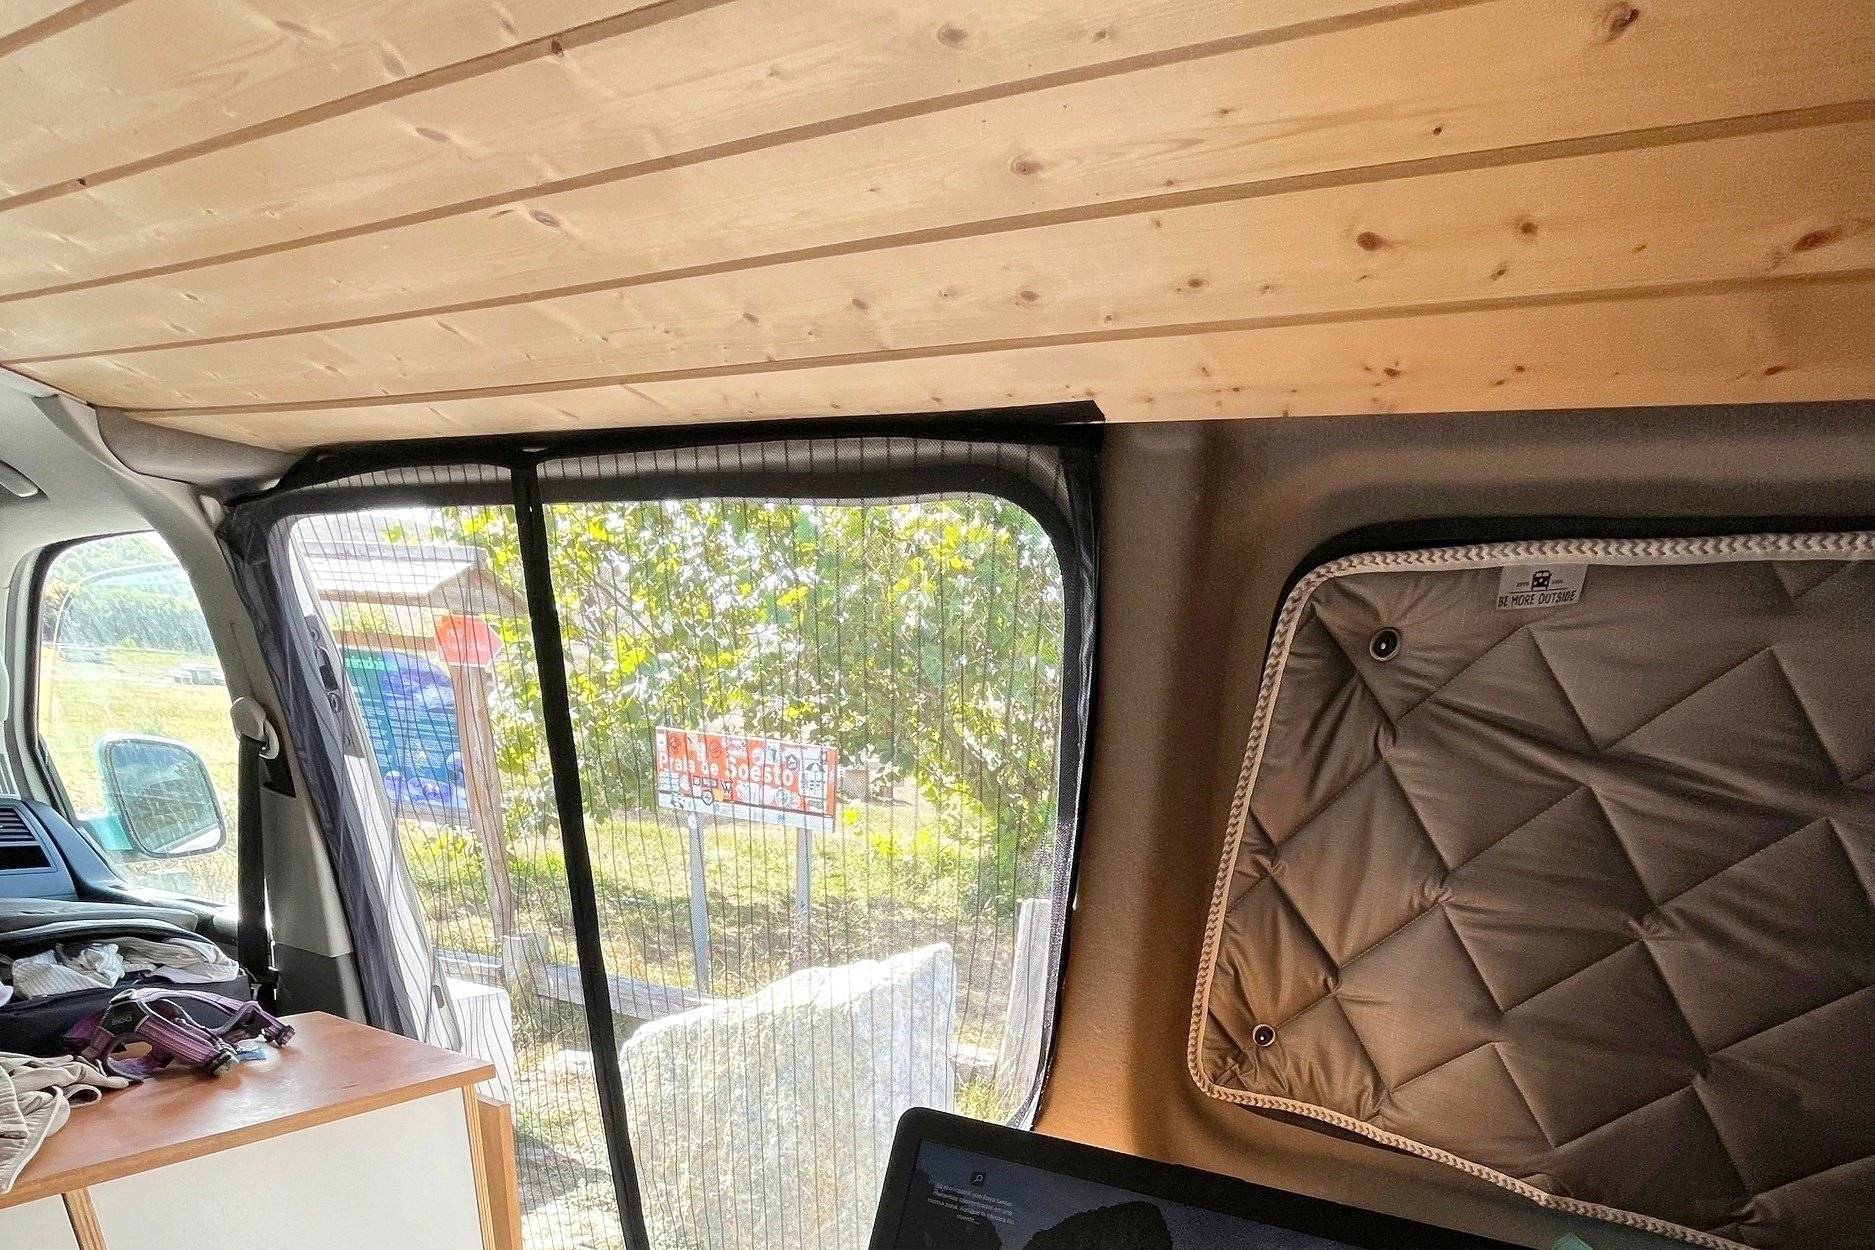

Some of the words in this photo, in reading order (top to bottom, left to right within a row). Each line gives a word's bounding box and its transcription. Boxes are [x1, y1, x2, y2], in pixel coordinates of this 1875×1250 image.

[1498, 596, 1508, 607] BE
[1511, 594, 1535, 606] MORE
[1538, 590, 1577, 605] OUTSIDE
